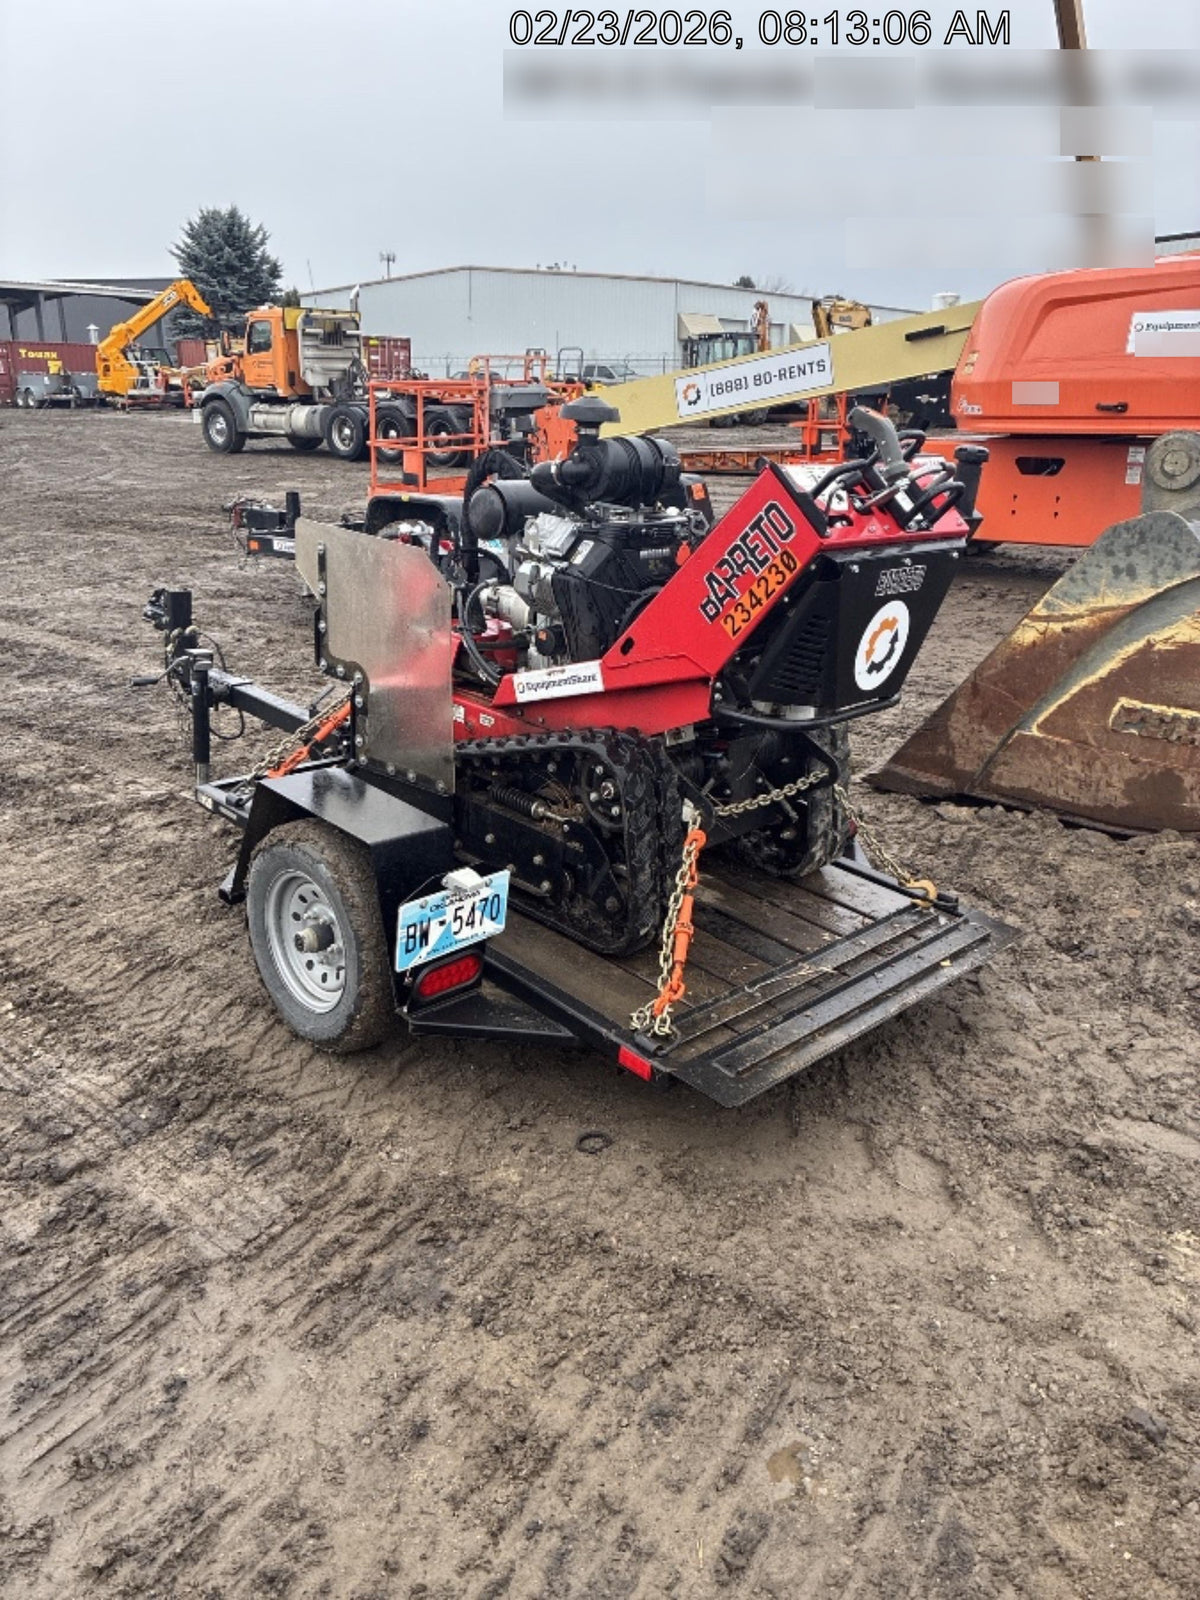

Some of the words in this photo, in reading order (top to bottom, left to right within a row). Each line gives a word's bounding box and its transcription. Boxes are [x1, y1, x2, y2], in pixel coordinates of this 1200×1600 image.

[752, 358, 827, 387] 80-RENTS
[698, 500, 796, 624] BARRETO
[722, 549, 799, 637] 234230
